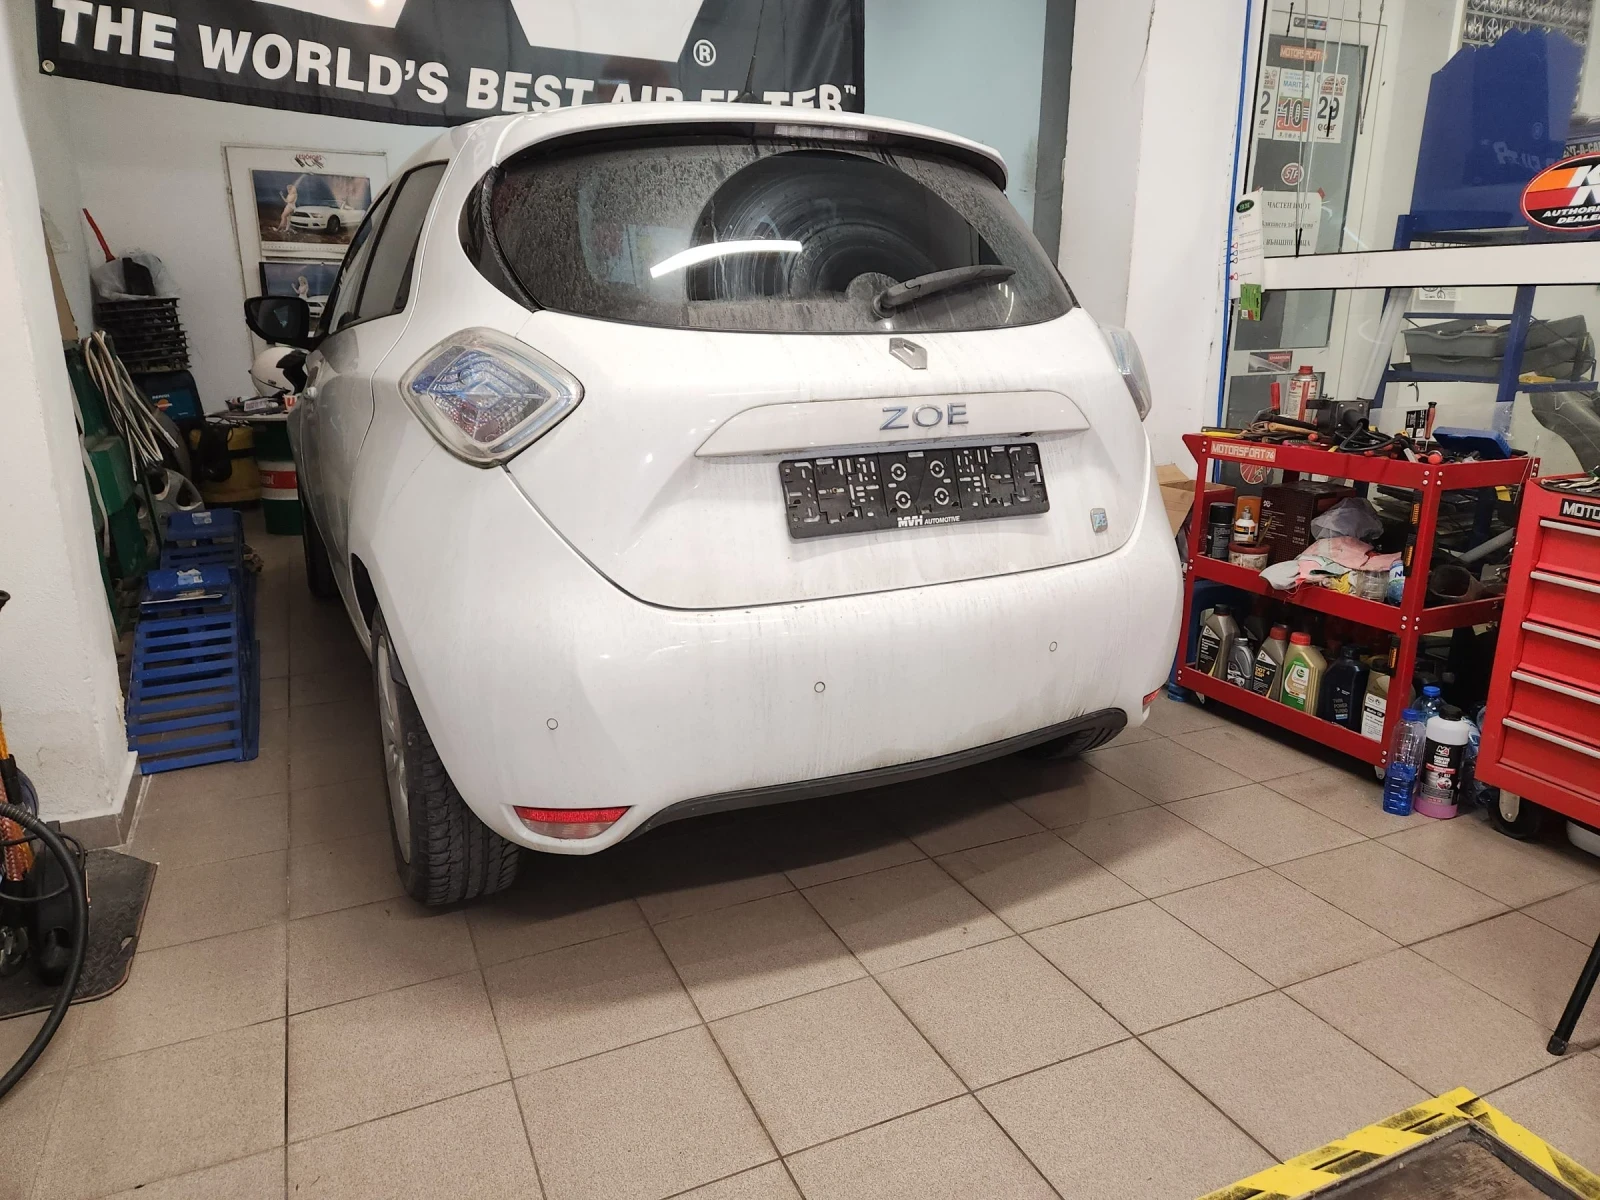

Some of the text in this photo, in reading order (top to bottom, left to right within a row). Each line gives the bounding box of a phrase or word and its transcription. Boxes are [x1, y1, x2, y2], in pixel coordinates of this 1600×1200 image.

[52, 0, 177, 61] THE
[198, 24, 449, 103] WORLD'S
[466, 67, 595, 112] BEST
[1283, 80, 1310, 89] MARITA
[1282, 98, 1303, 128] 10
[880, 403, 969, 431] ZOE
[1212, 441, 1265, 459] MOTORSPORT
[924, 515, 960, 525] AUTOMOTIVE
